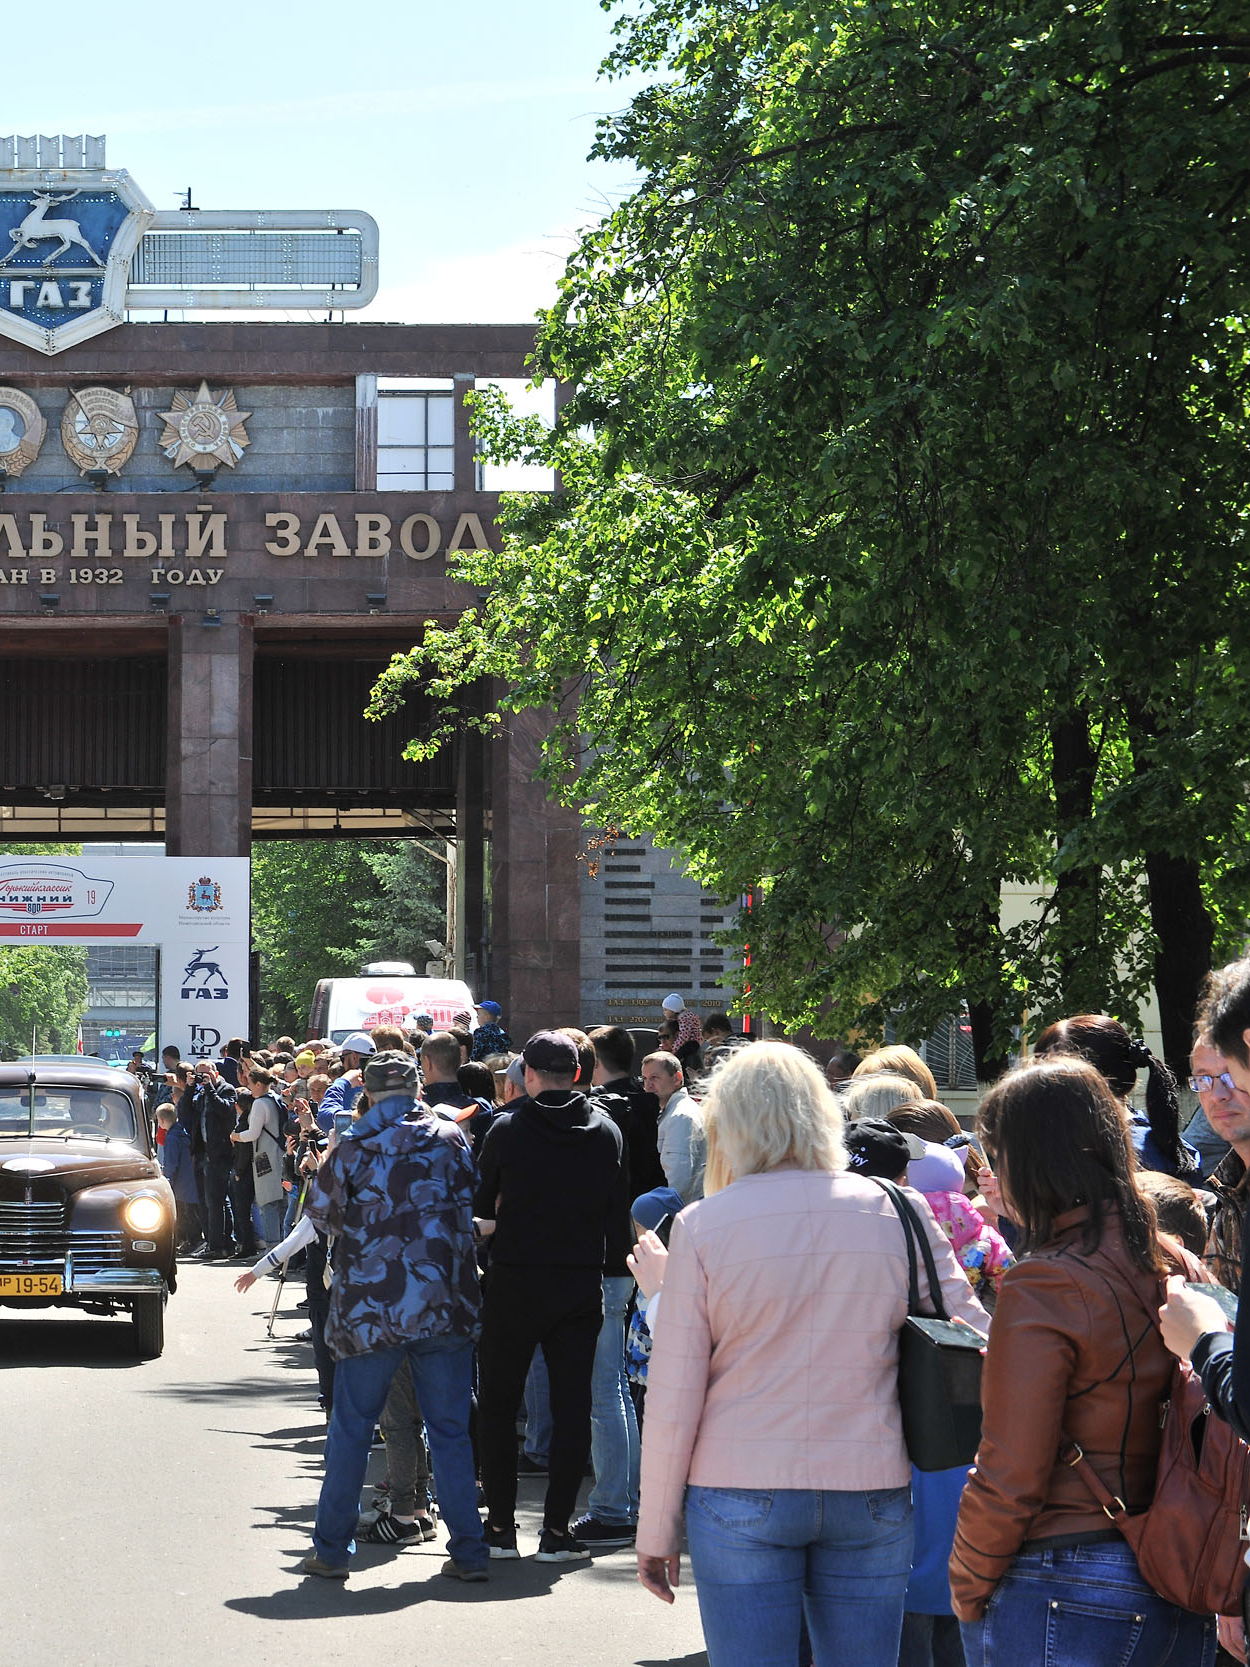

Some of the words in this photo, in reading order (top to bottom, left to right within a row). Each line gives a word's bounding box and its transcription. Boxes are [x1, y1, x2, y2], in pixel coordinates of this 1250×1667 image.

[9, 280, 92, 309] ГАЗ
[264, 511, 494, 562] ЗАВОД
[41, 568, 57, 585] В
[70, 567, 124, 585] 1932
[151, 568, 225, 587] ГОДУ
[86, 890, 96, 905] 19
[27, 903, 41, 914] 800
[19, 924, 49, 936] СТАРТ
[180, 987, 229, 1000] ГАЗ
[16, 1277, 59, 1294] 19-54
